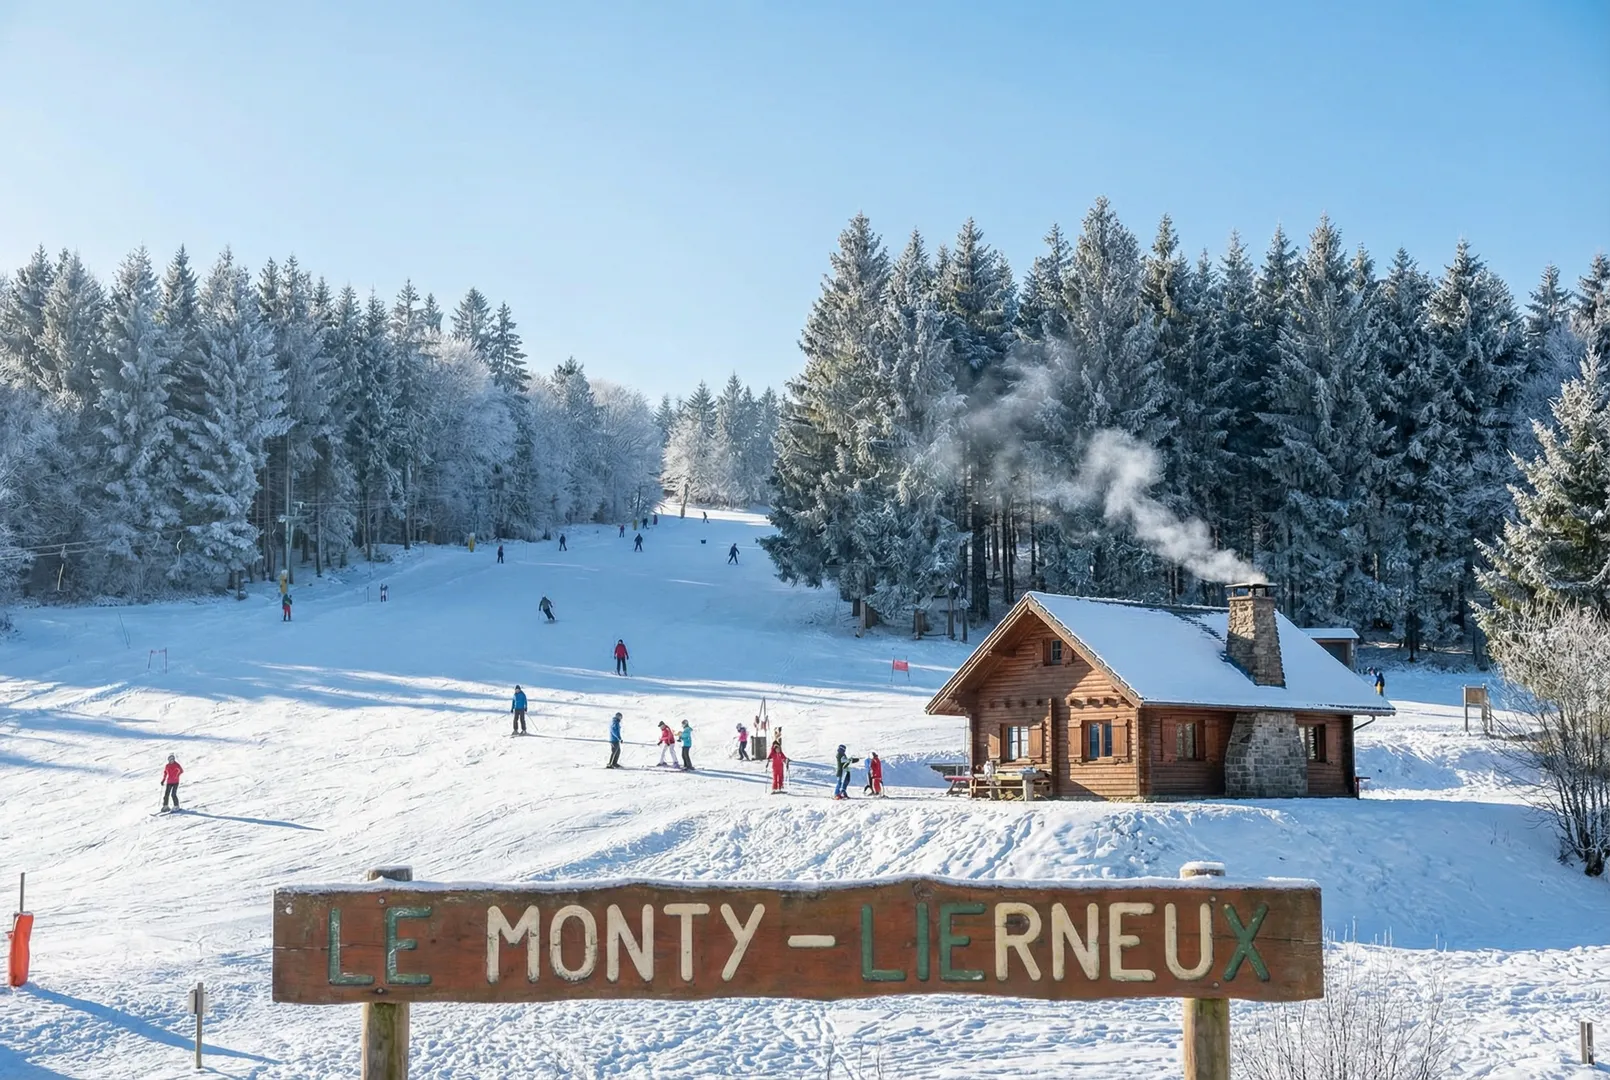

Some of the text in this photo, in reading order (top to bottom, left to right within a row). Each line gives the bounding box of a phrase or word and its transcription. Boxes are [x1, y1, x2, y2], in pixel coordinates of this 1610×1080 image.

[327, 906, 433, 985] LE
[486, 903, 766, 983] MONTY
[860, 902, 1271, 982] LIERNEUX
